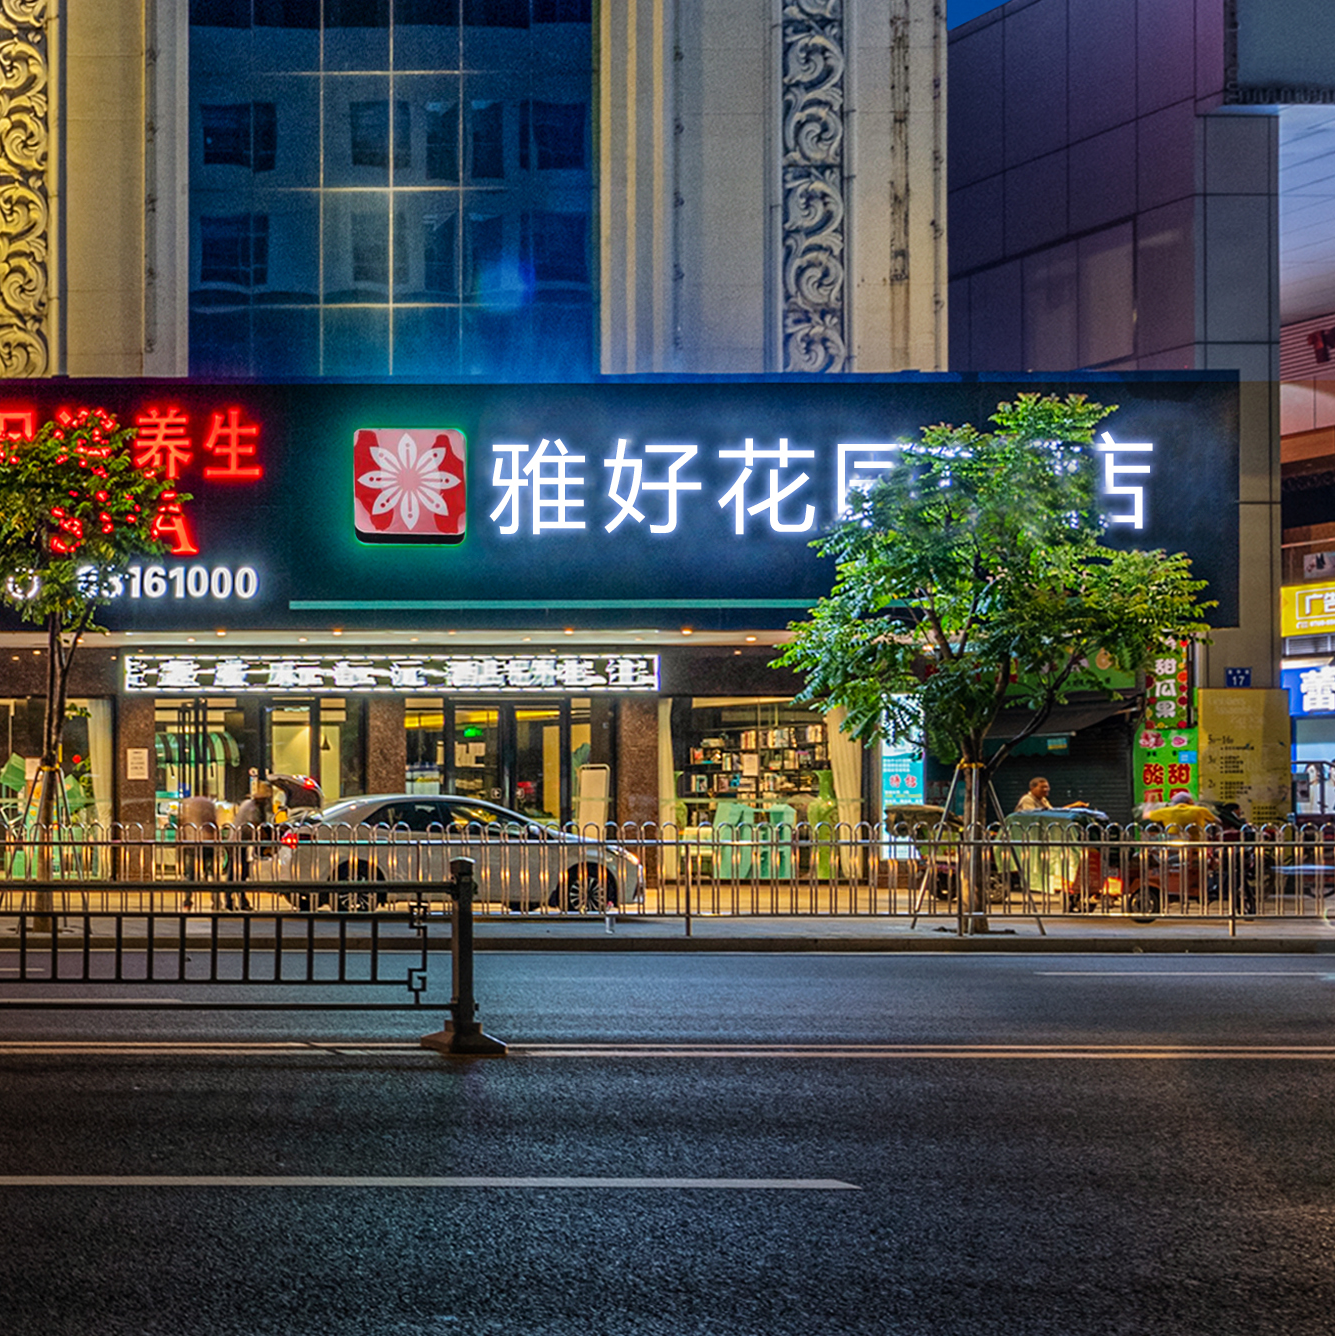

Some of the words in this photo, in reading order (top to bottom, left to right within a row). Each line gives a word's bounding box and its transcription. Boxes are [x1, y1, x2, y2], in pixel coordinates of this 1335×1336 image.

[489, 432, 1154, 536] 雅好花店
[1232, 675, 1245, 686] 17
[1143, 763, 1191, 786] 酸甜
